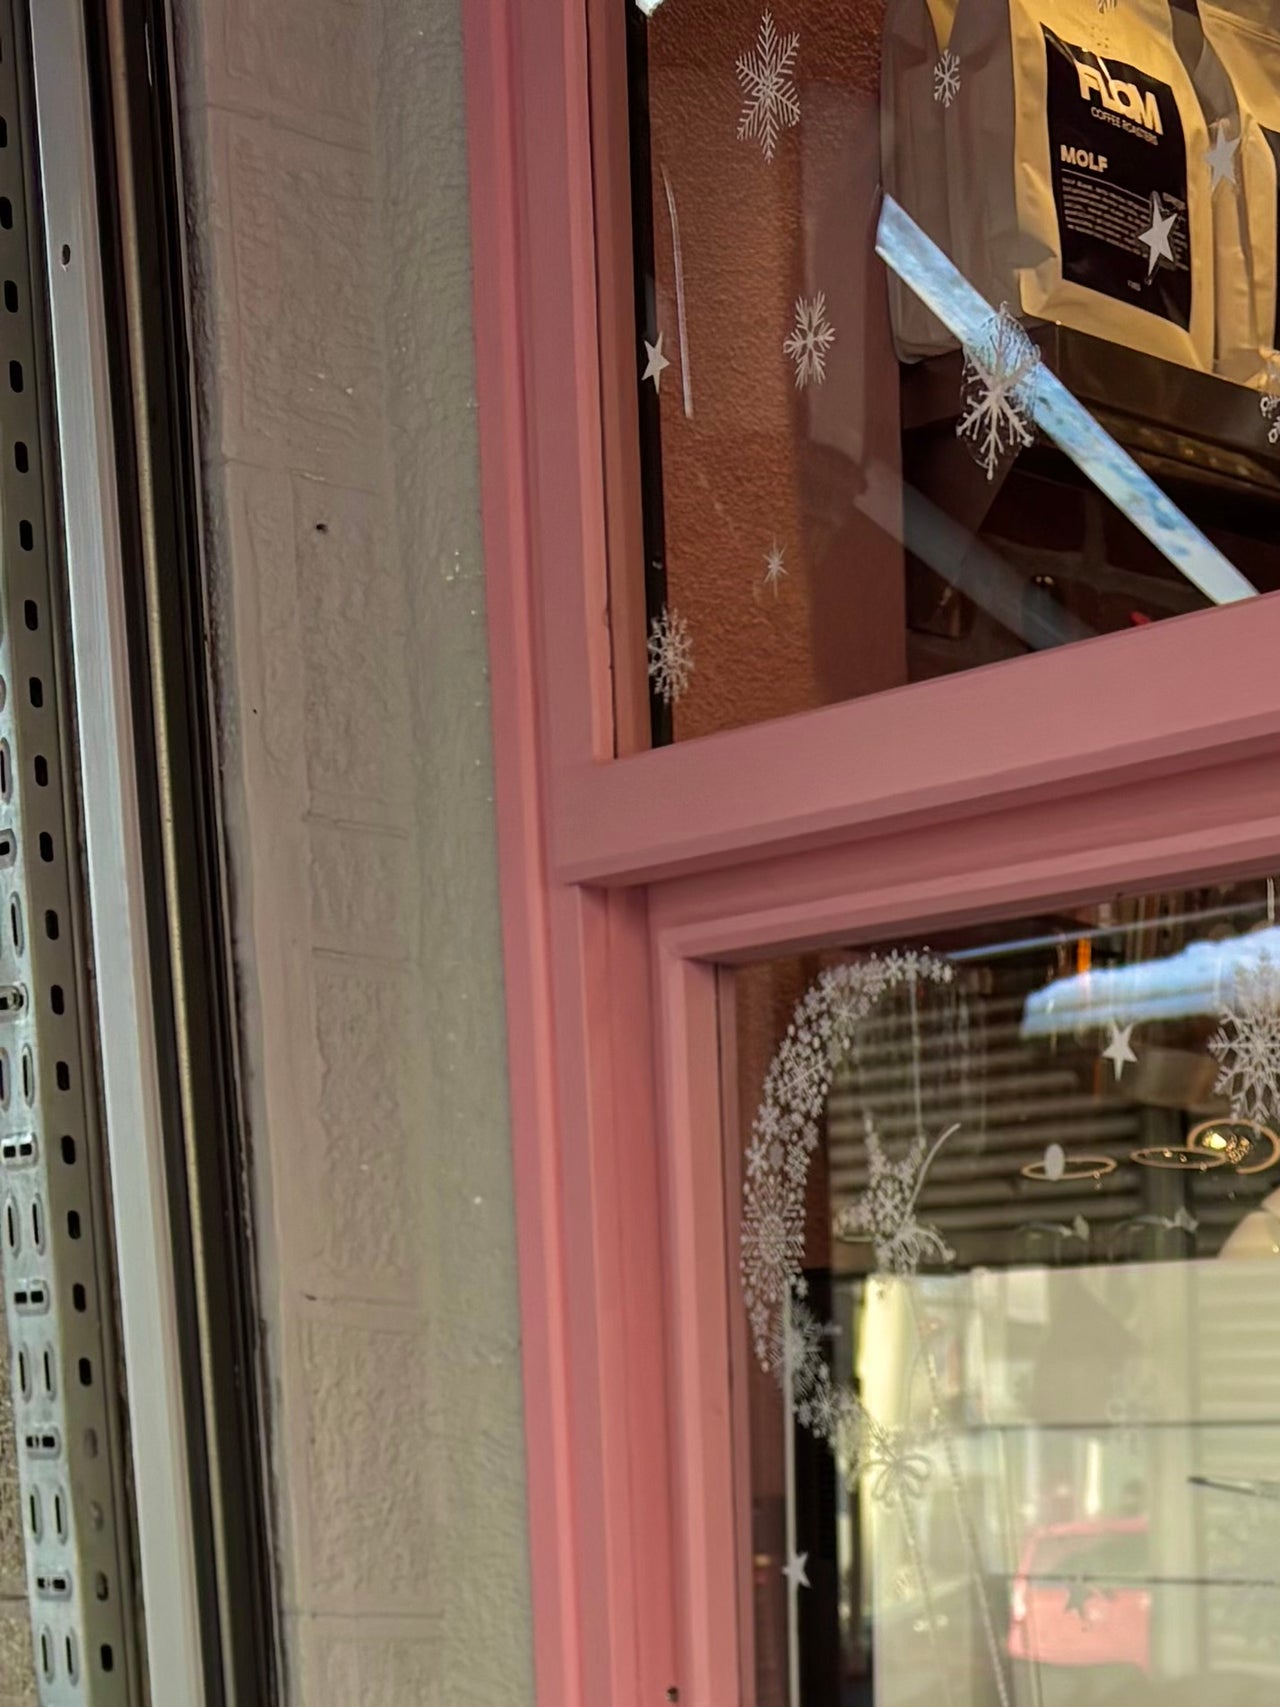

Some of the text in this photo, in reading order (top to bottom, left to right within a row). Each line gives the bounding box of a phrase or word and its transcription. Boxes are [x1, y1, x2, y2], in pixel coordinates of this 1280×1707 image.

[1073, 58, 1164, 136] FLOM
[1090, 106, 1122, 128] COFFEE
[1060, 144, 1108, 173] MOLF
